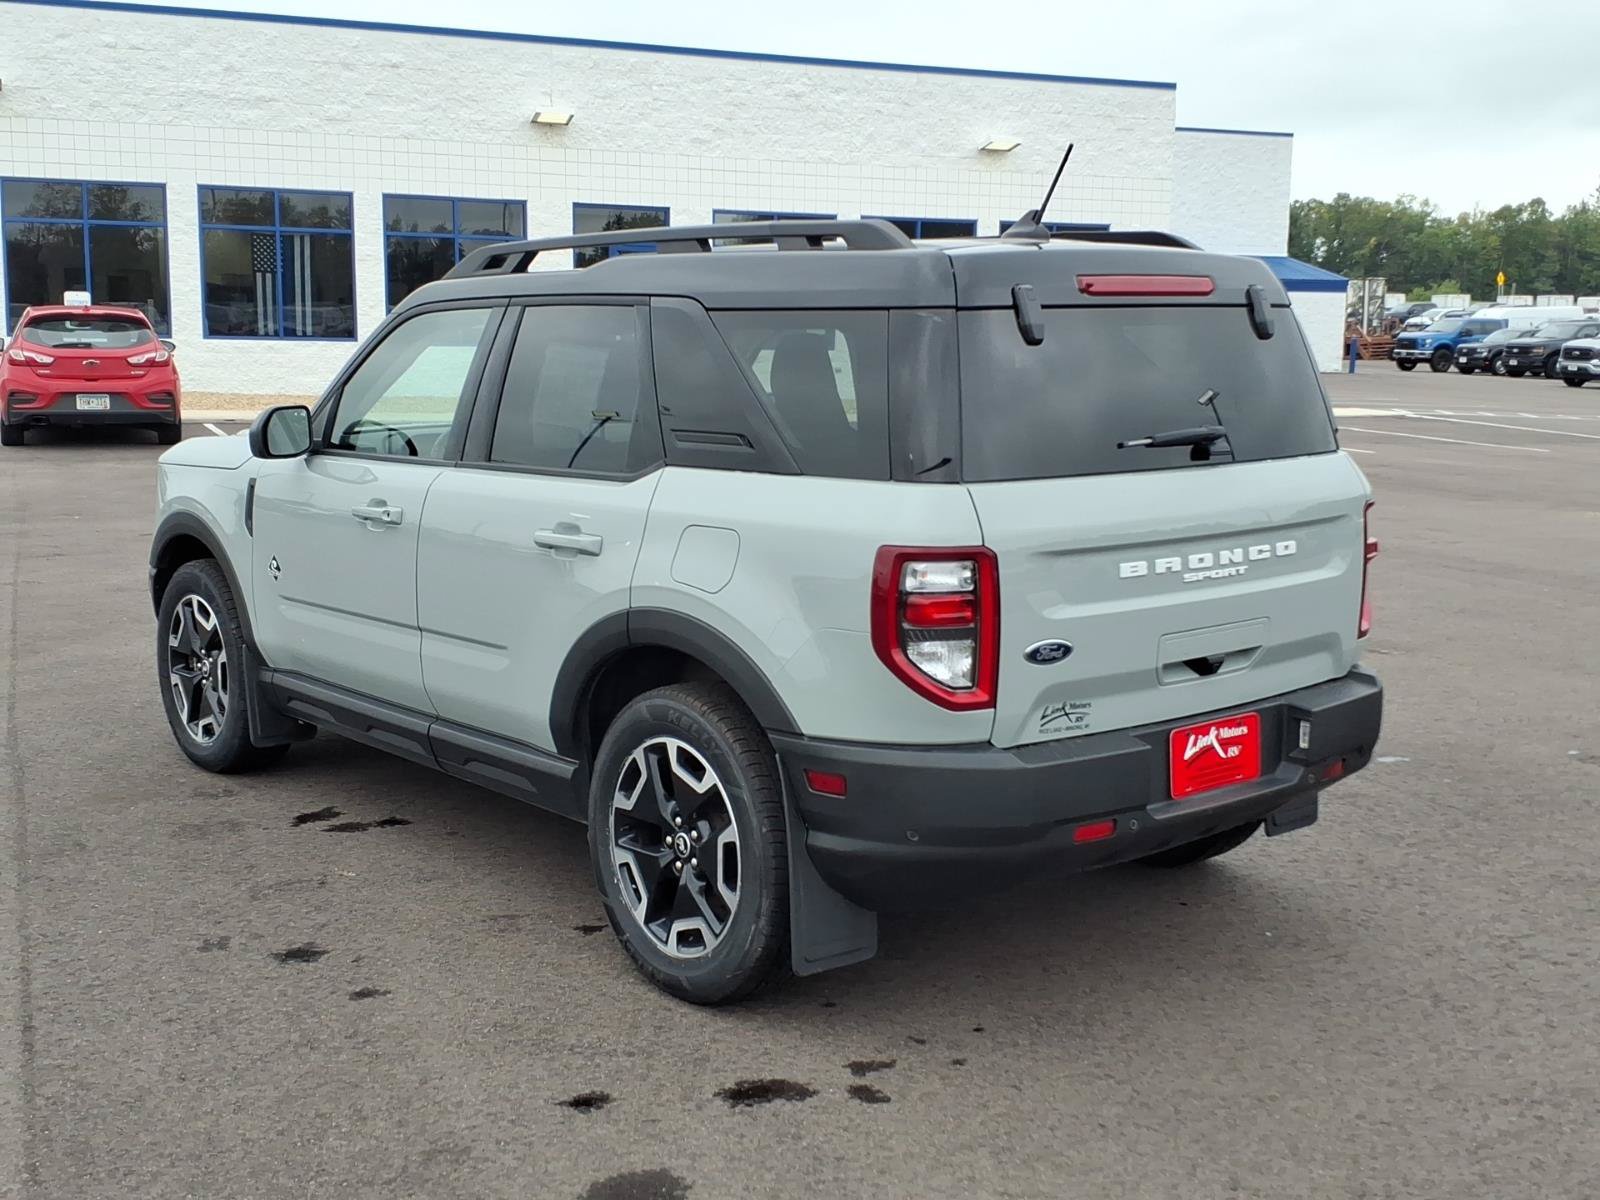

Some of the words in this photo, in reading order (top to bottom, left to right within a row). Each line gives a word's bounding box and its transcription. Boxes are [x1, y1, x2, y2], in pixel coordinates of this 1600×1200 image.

[1119, 540, 1297, 578] BRONCO
[1183, 565, 1248, 583] SPORT
[1036, 645, 1065, 661] Ford
[1183, 726, 1227, 760] Link
[1218, 726, 1248, 739] Motors
